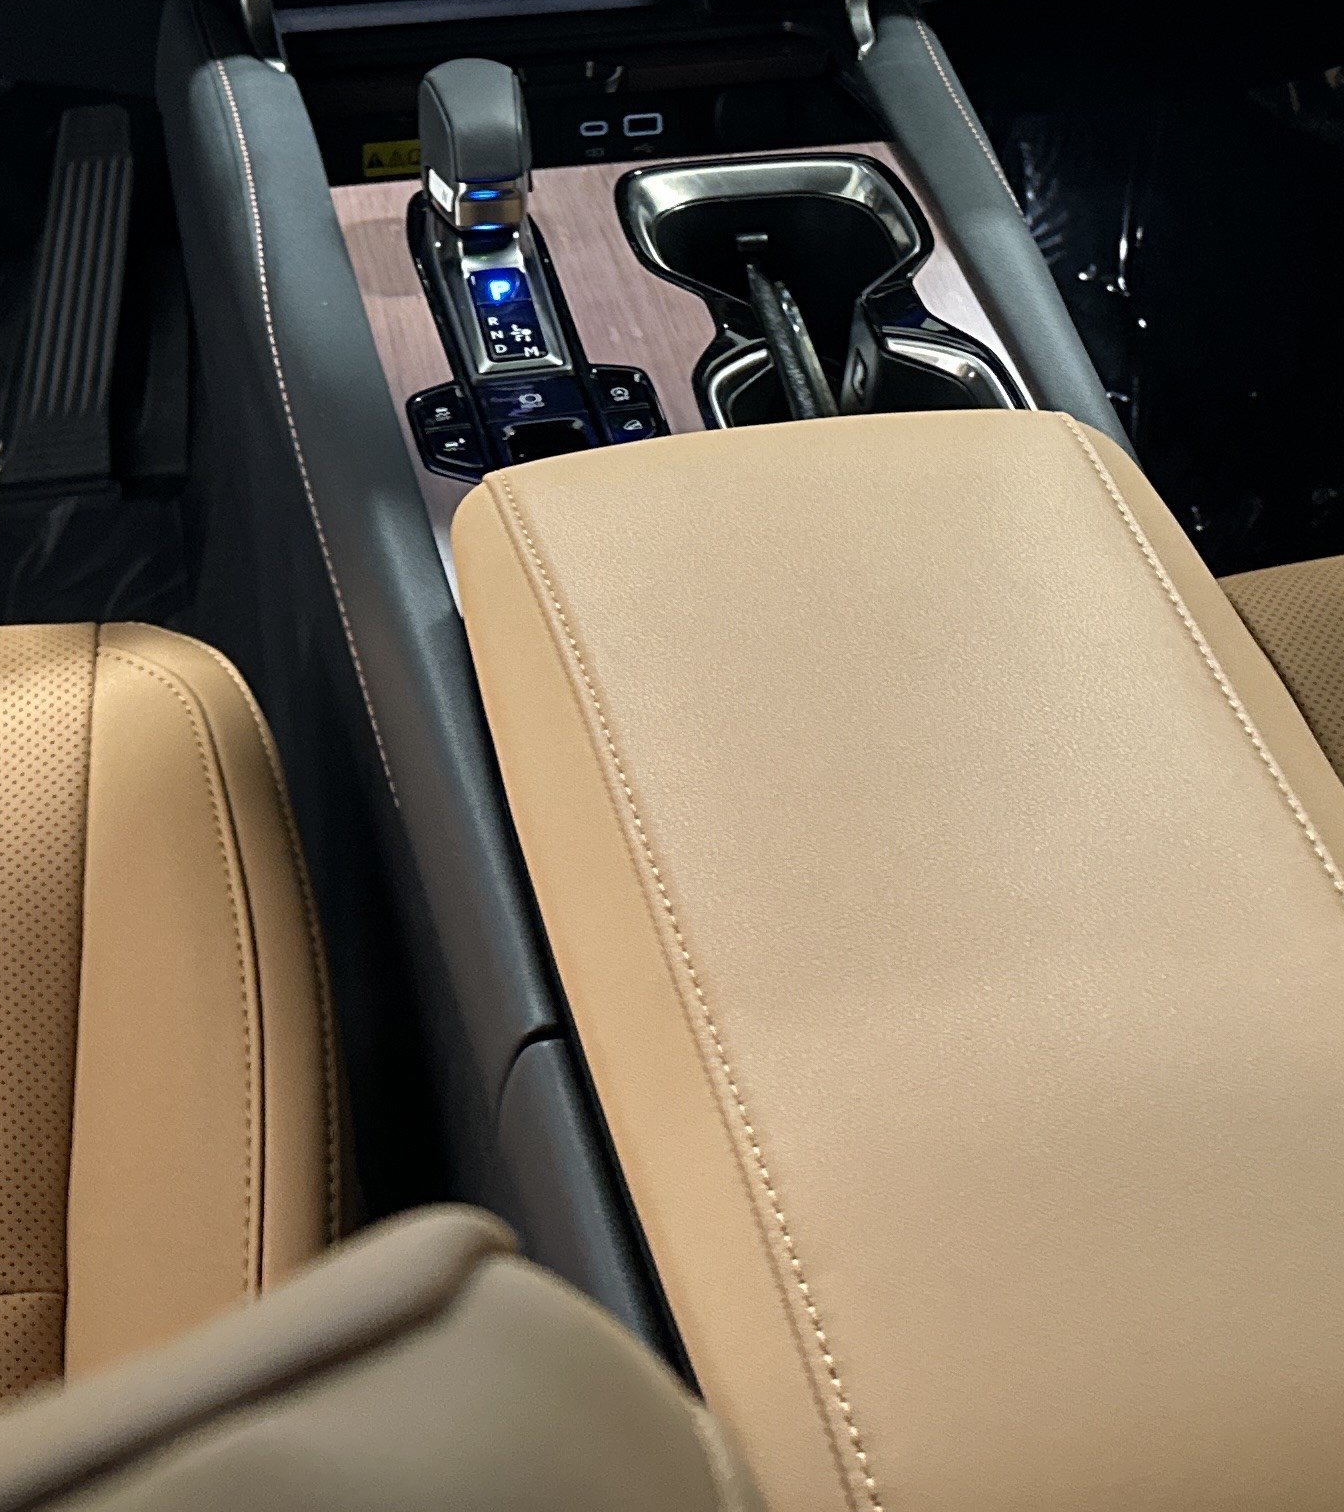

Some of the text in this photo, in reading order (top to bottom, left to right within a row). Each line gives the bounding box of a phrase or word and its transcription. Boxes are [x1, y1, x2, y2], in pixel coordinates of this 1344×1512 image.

[488, 279, 512, 301] P
[487, 316, 500, 326] R
[490, 330, 505, 340] N
[494, 344, 508, 354] D
[523, 345, 541, 358] M
